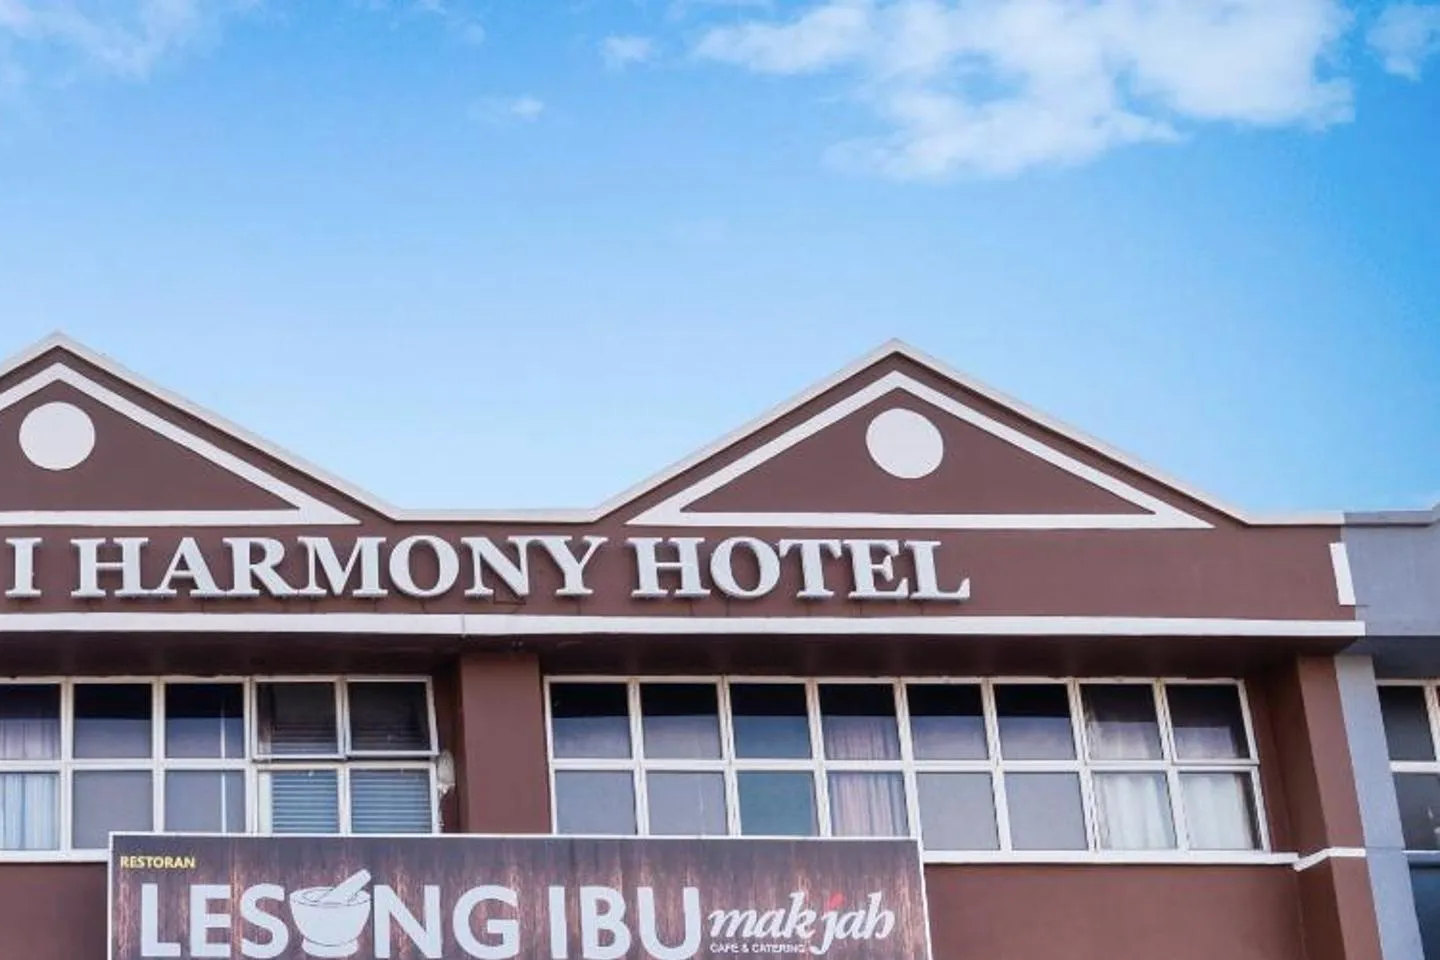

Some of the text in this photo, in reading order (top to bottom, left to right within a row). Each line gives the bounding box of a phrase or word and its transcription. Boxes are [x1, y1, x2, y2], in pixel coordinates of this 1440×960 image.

[3, 535, 971, 600] I HARMONY HOTEL
[120, 855, 196, 870] RESTORAN
[708, 891, 816, 939] mak
[710, 943, 805, 953] CAFE & CATERING
